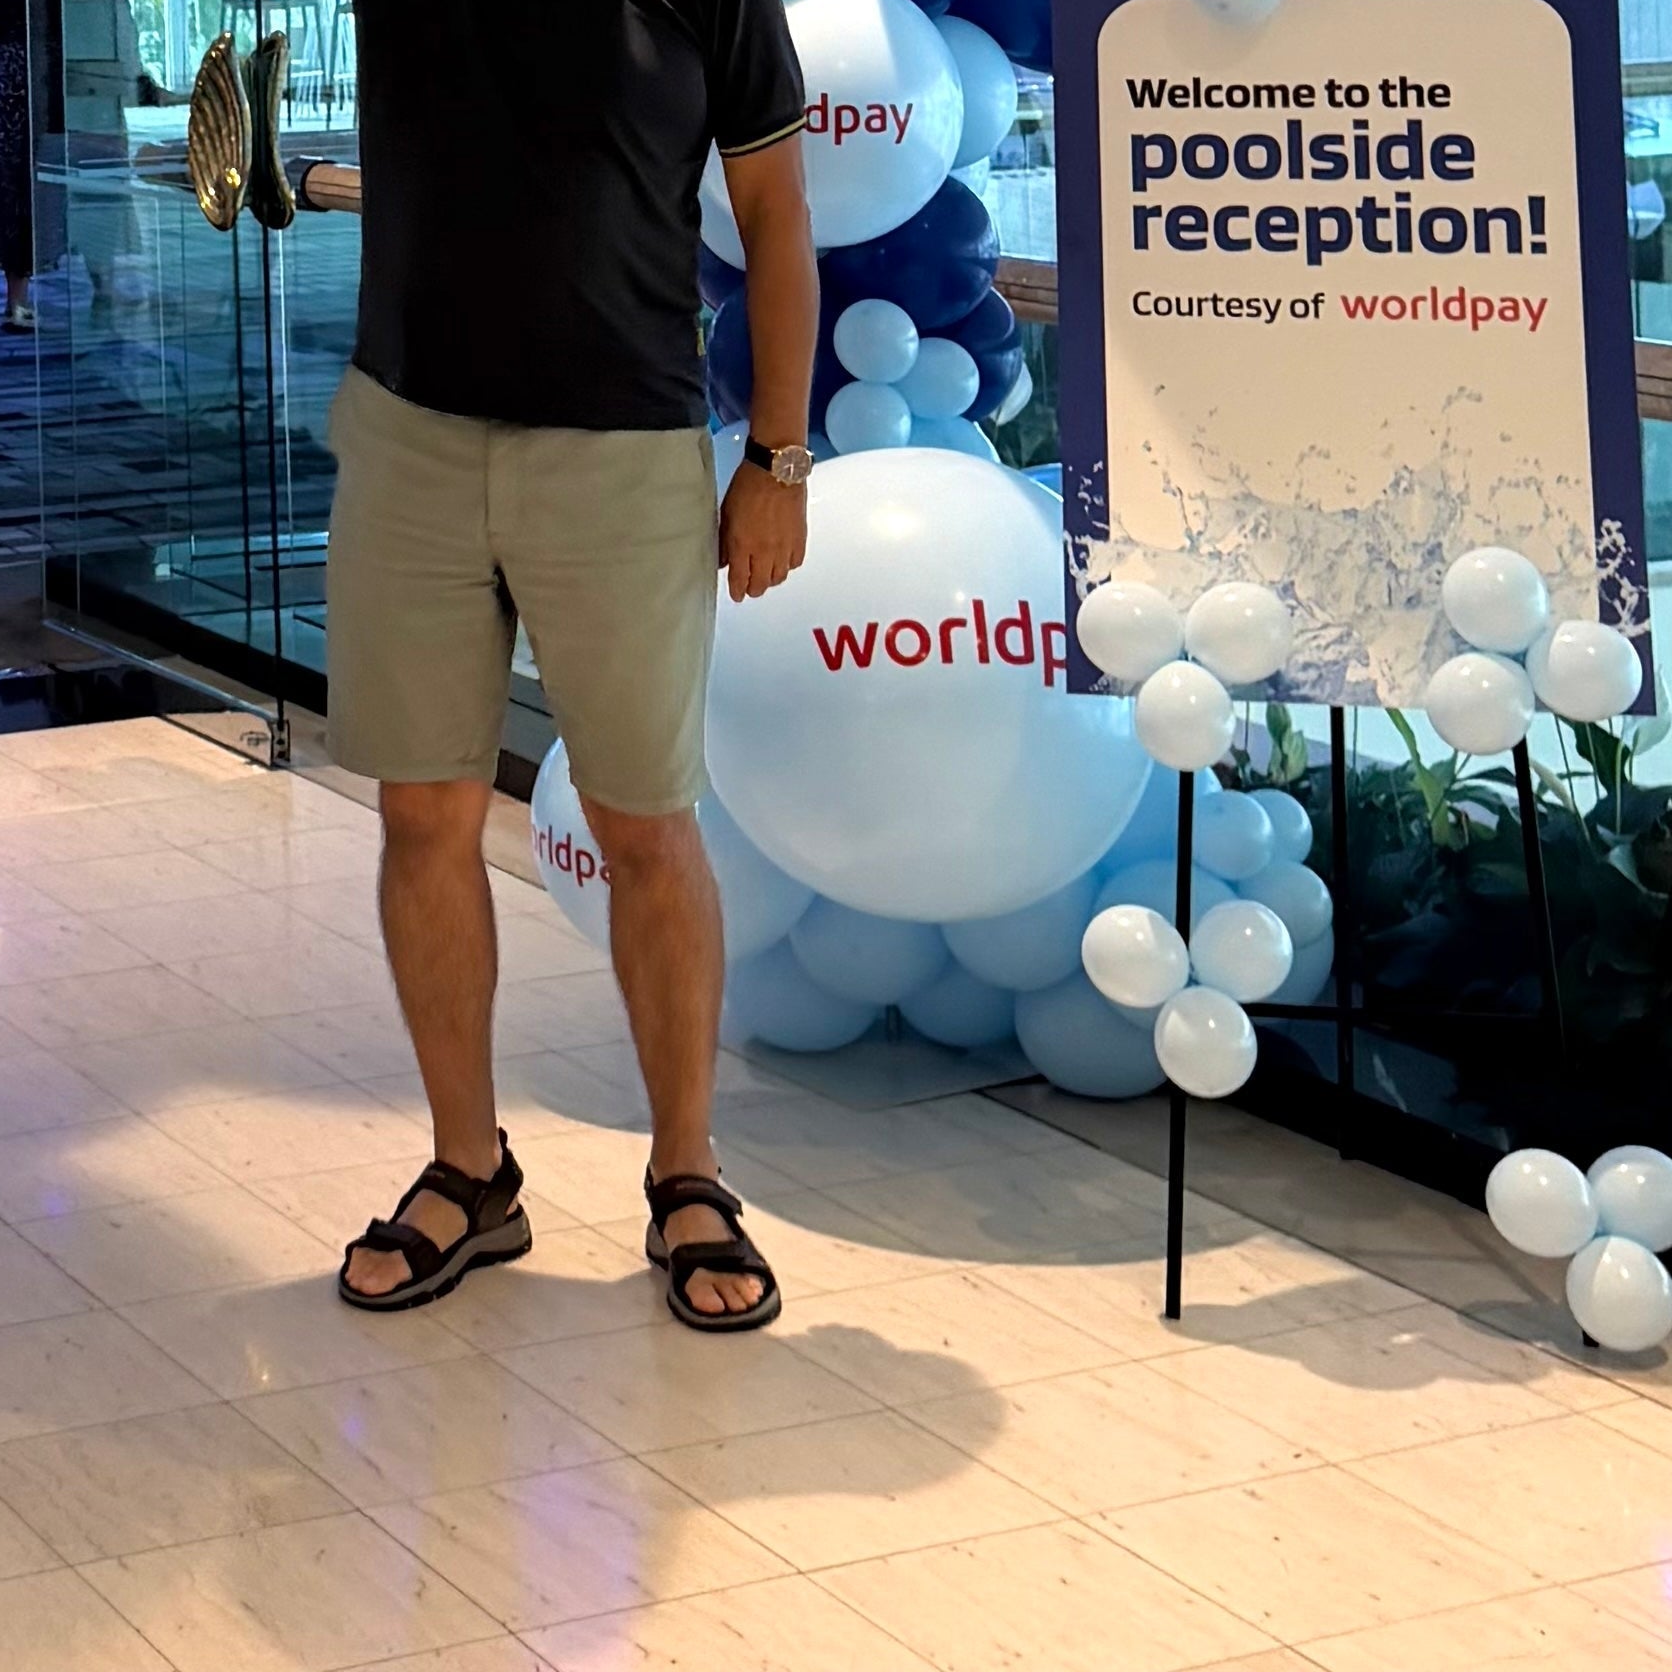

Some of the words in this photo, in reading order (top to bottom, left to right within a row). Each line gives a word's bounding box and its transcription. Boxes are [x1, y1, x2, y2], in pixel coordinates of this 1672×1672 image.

[804, 92, 913, 146] dpay
[1126, 77, 1316, 109] Welcome
[1325, 78, 1370, 108] to
[1379, 76, 1452, 108] the
[1130, 119, 1476, 193] poolside
[1132, 192, 1547, 266] reception!
[1132, 291, 1281, 324] Courtesy
[1289, 292, 1325, 319] of
[1340, 286, 1548, 331] worldpay
[813, 599, 1066, 687] worldp
